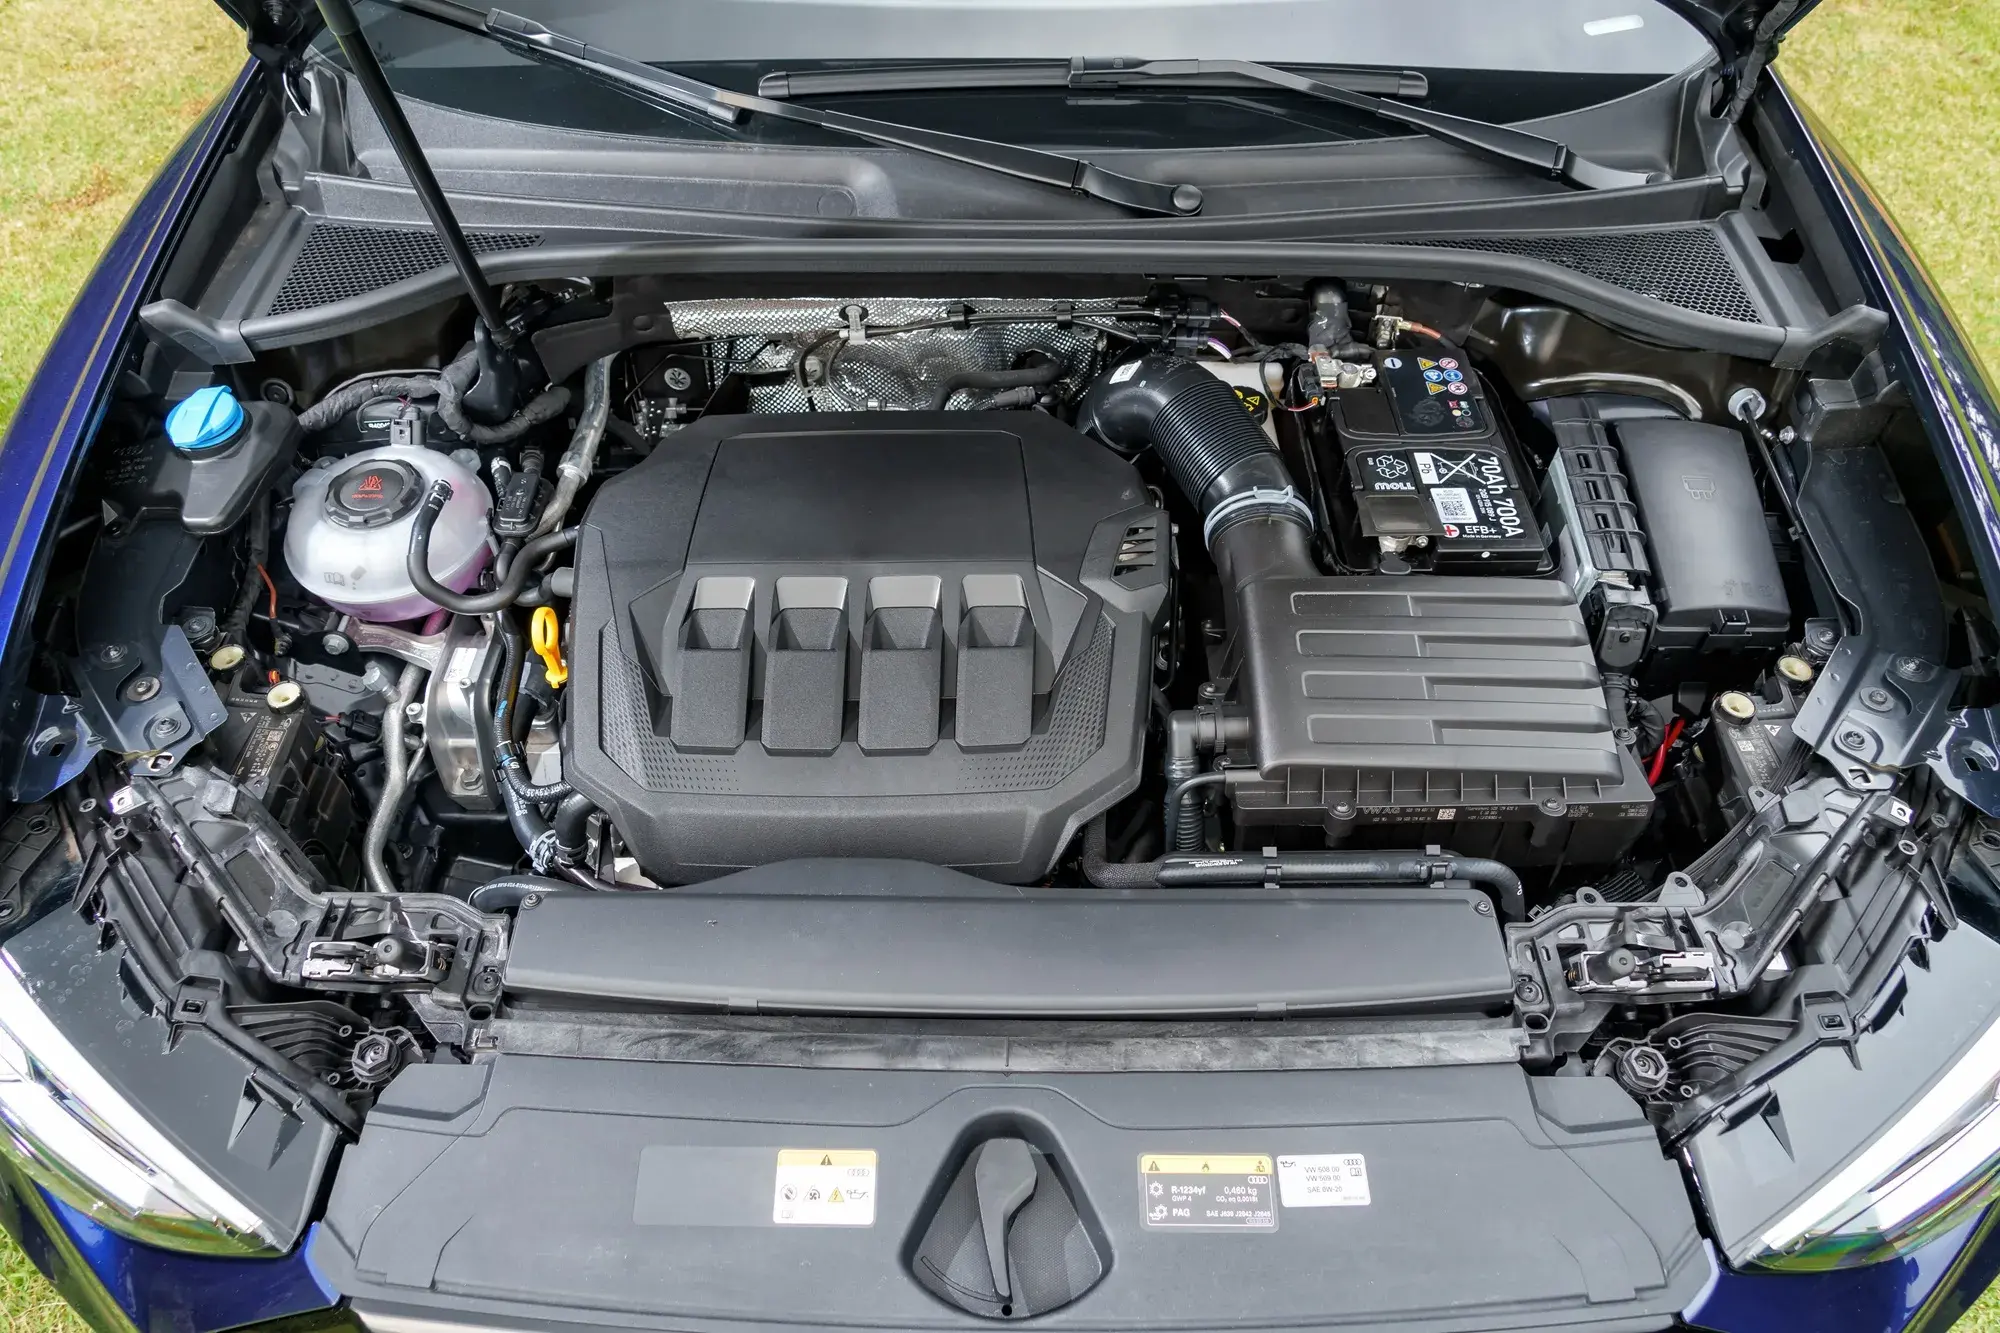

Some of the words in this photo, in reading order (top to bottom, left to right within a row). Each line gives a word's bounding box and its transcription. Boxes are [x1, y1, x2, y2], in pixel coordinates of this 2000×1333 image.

[1478, 456, 1508, 495] 70Ah
[1493, 498, 1525, 538] 700A
[1464, 525, 1497, 534] EFB+
[1362, 806, 1382, 815] VW
[1171, 1185, 1206, 1196] R-1234yf
[1247, 1186, 1258, 1196] kg
[1172, 1208, 1191, 1217] PAG
